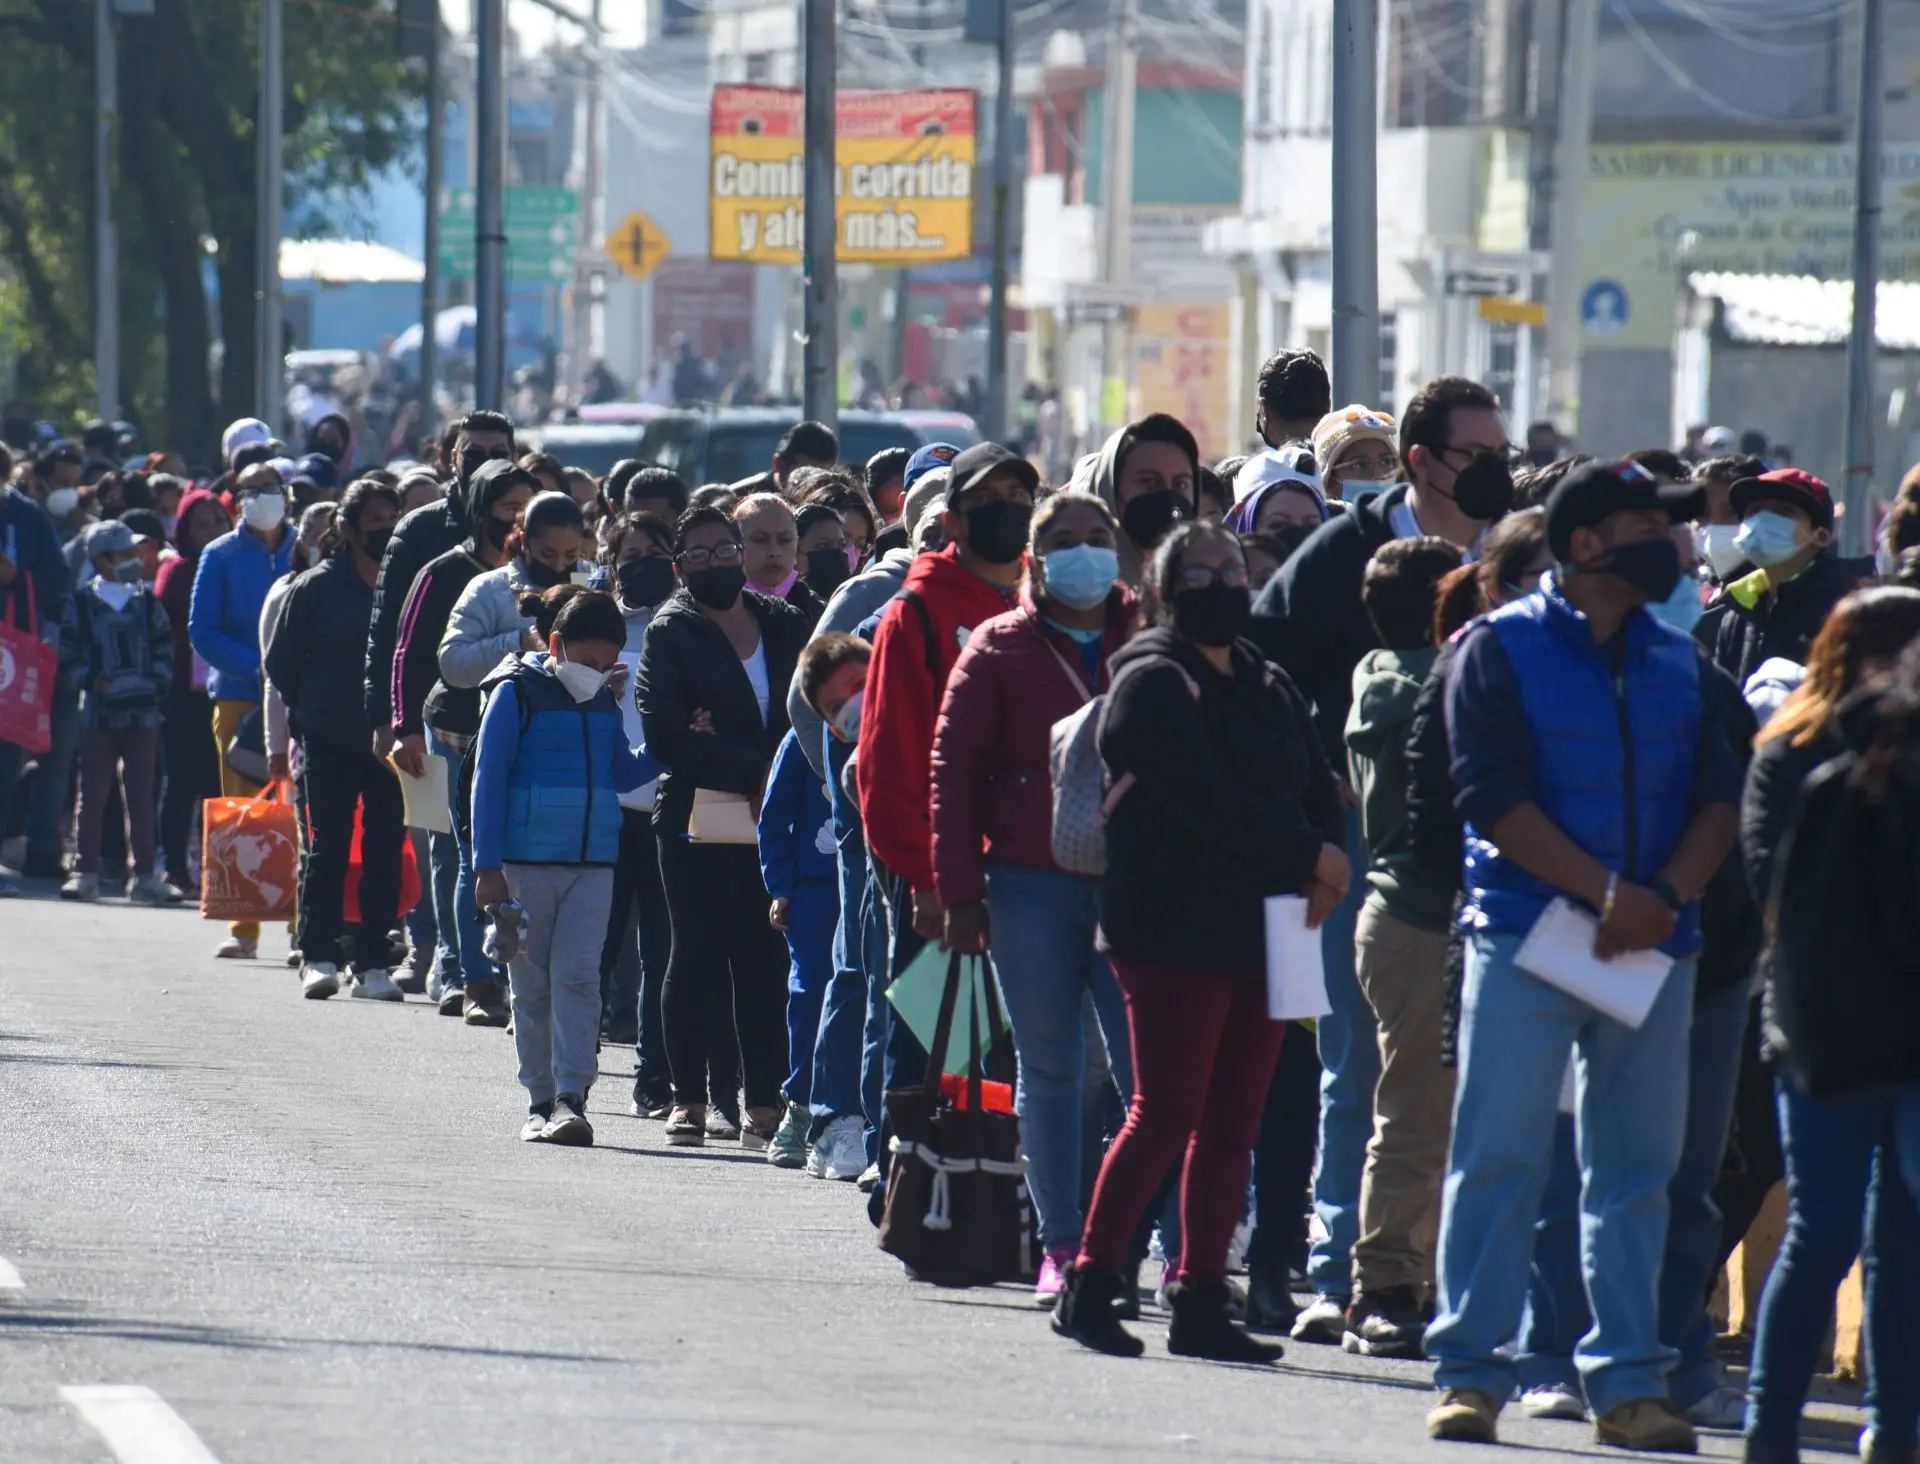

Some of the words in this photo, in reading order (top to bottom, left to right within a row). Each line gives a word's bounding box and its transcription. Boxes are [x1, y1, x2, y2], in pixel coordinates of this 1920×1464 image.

[714, 152, 844, 198] Comi
[851, 153, 971, 198] corrida
[738, 210, 759, 253] y
